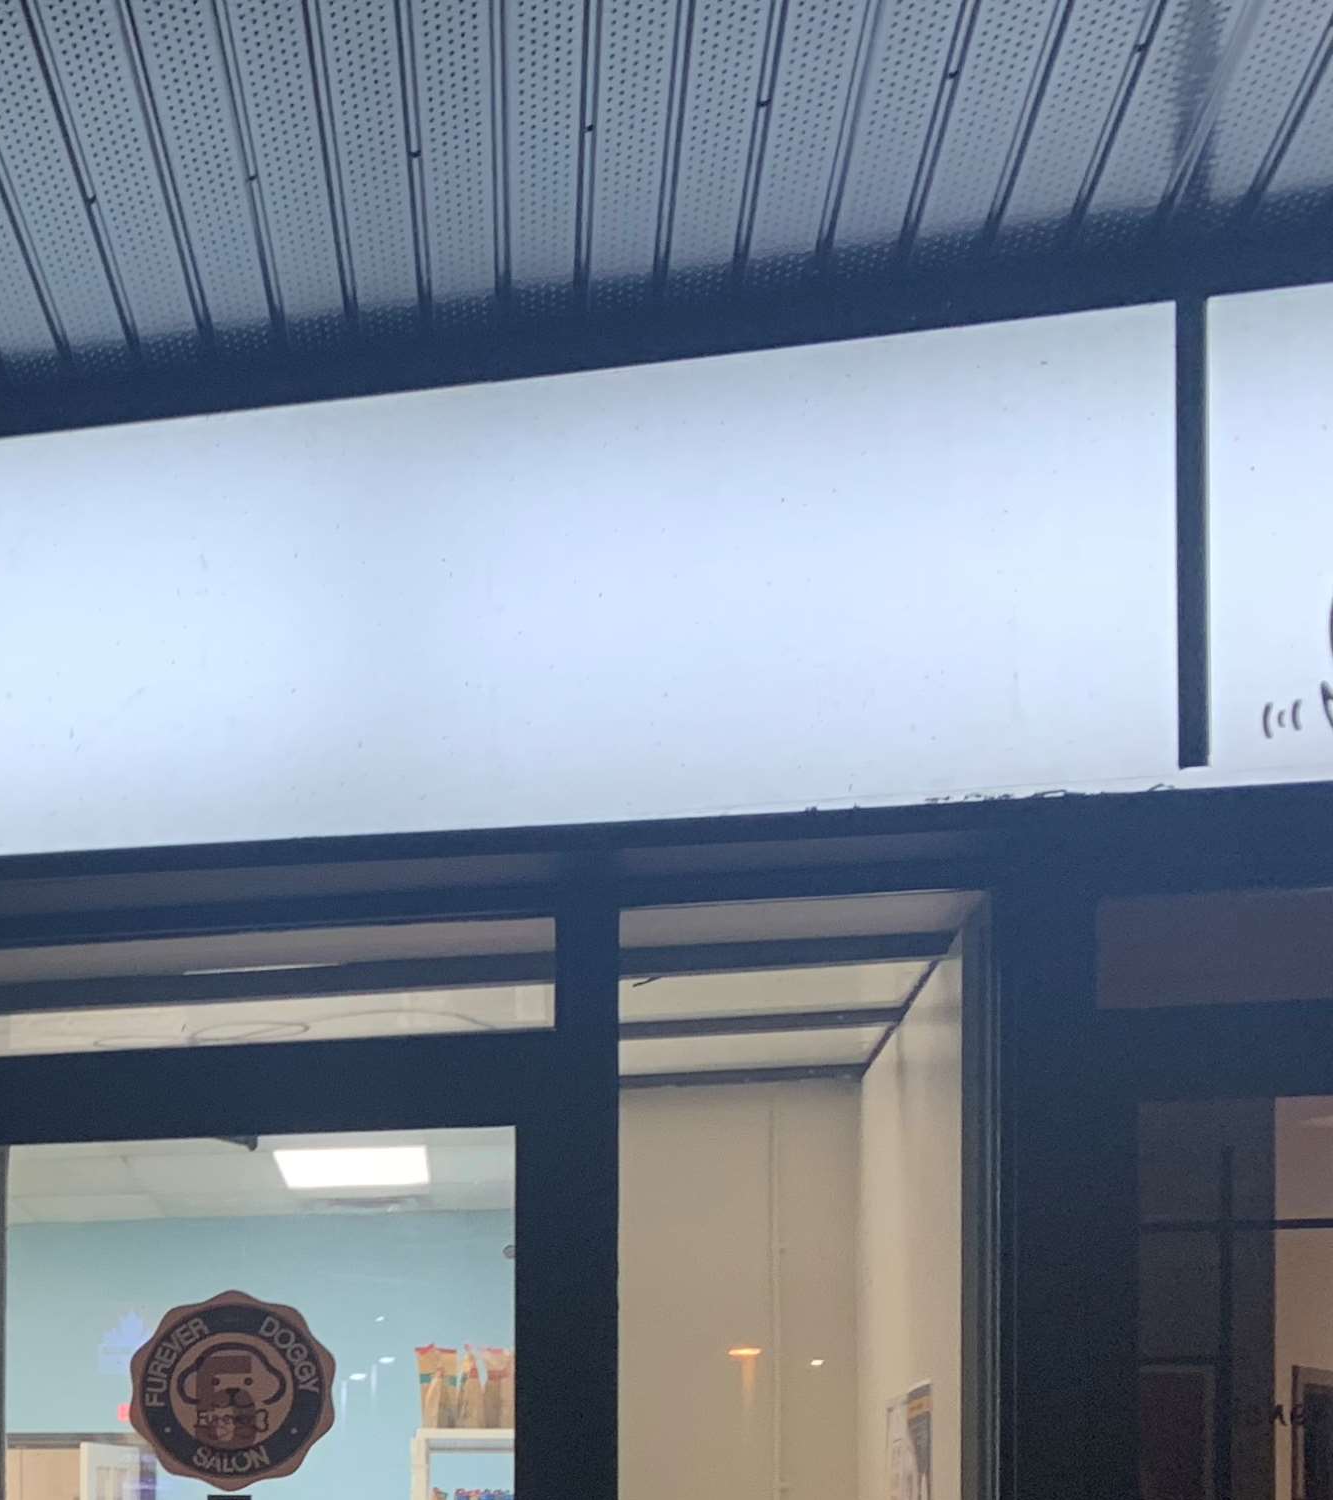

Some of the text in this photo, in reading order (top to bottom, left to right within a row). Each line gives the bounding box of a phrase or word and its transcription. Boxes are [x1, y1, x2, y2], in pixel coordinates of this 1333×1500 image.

[145, 1315, 320, 1408] FUREVER DOGGY
[193, 1446, 270, 1474] SALON
